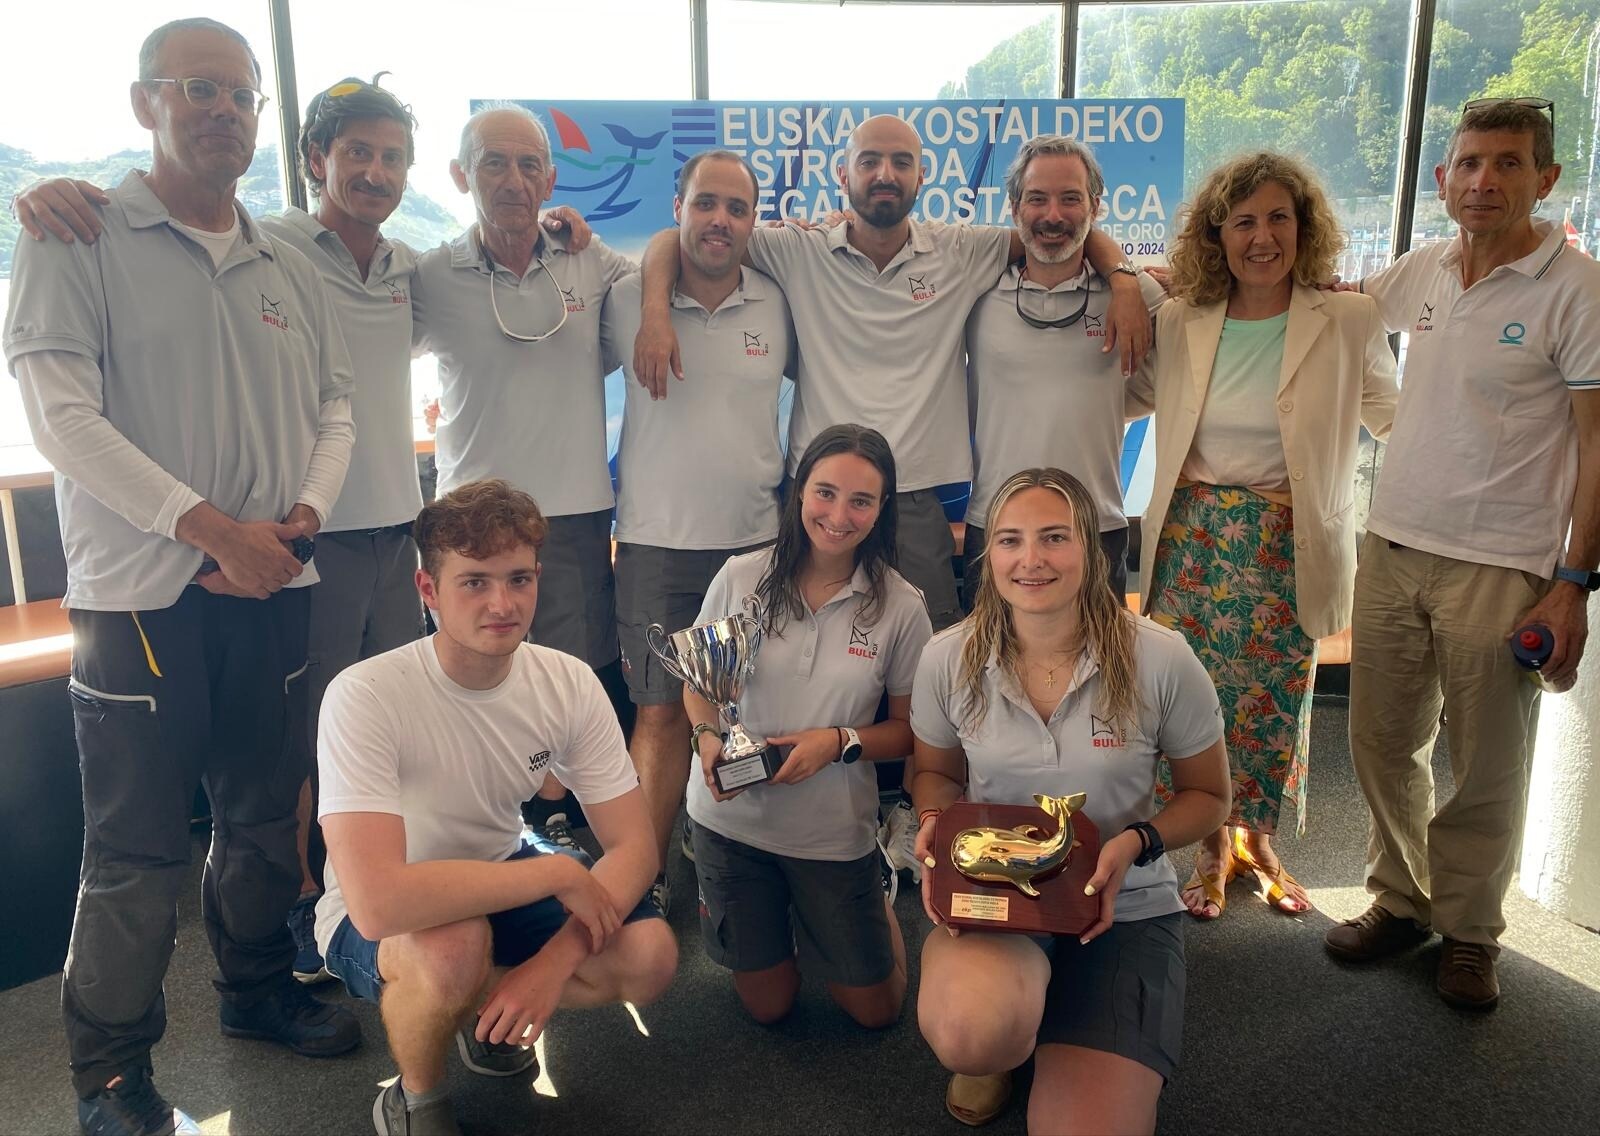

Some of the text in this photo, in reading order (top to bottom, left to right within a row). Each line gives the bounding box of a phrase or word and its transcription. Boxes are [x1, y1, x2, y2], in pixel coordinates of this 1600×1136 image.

[722, 107, 870, 147] EUSKA
[911, 187, 1014, 224] OSTA
[1095, 184, 1166, 222] SCA
[1128, 223, 1166, 240] ORO
[1137, 242, 1165, 255] 2024
[912, 291, 935, 301] BULL
[262, 314, 288, 331] BULL
[848, 646, 876, 660] BULL
[1093, 738, 1125, 748] BULL
[529, 750, 551, 765] VANS
